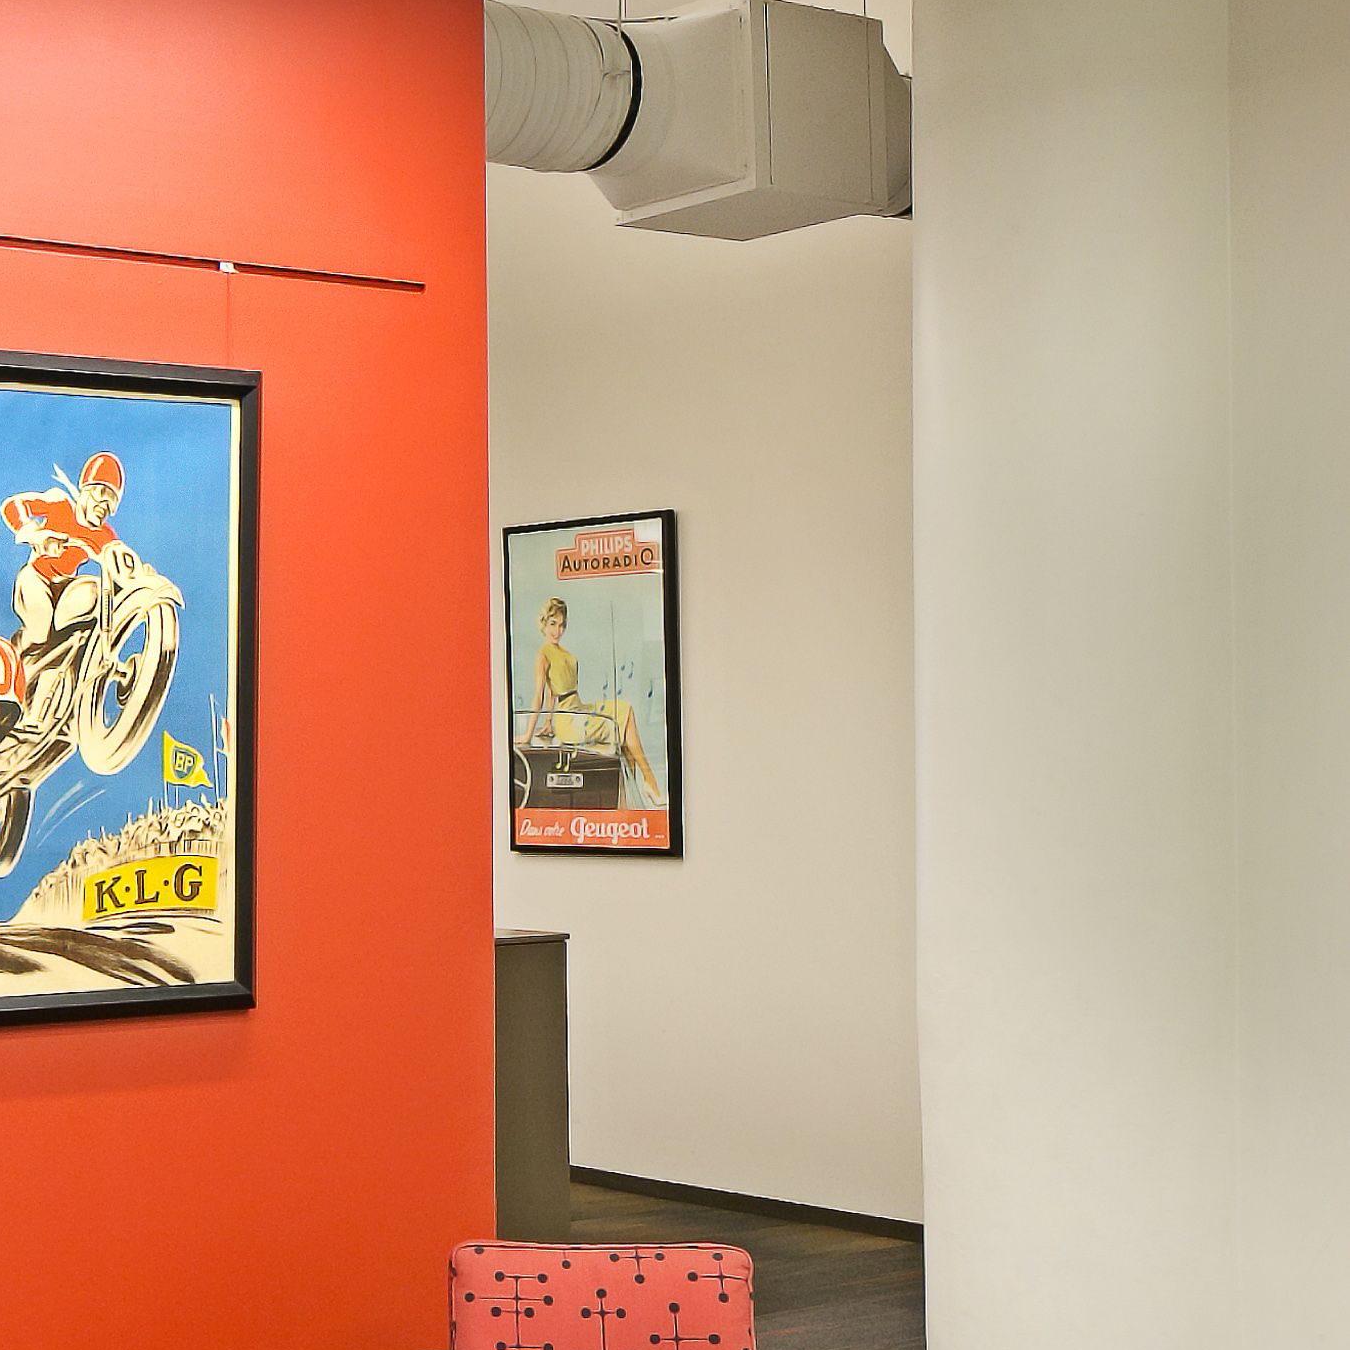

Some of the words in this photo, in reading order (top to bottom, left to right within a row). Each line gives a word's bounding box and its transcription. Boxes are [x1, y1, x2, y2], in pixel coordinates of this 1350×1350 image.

[581, 536, 633, 556] PHILIPS
[113, 550, 136, 580] 19
[561, 547, 654, 572] AUTORADIO
[175, 752, 194, 774] BP
[570, 816, 650, 844] Peugeot
